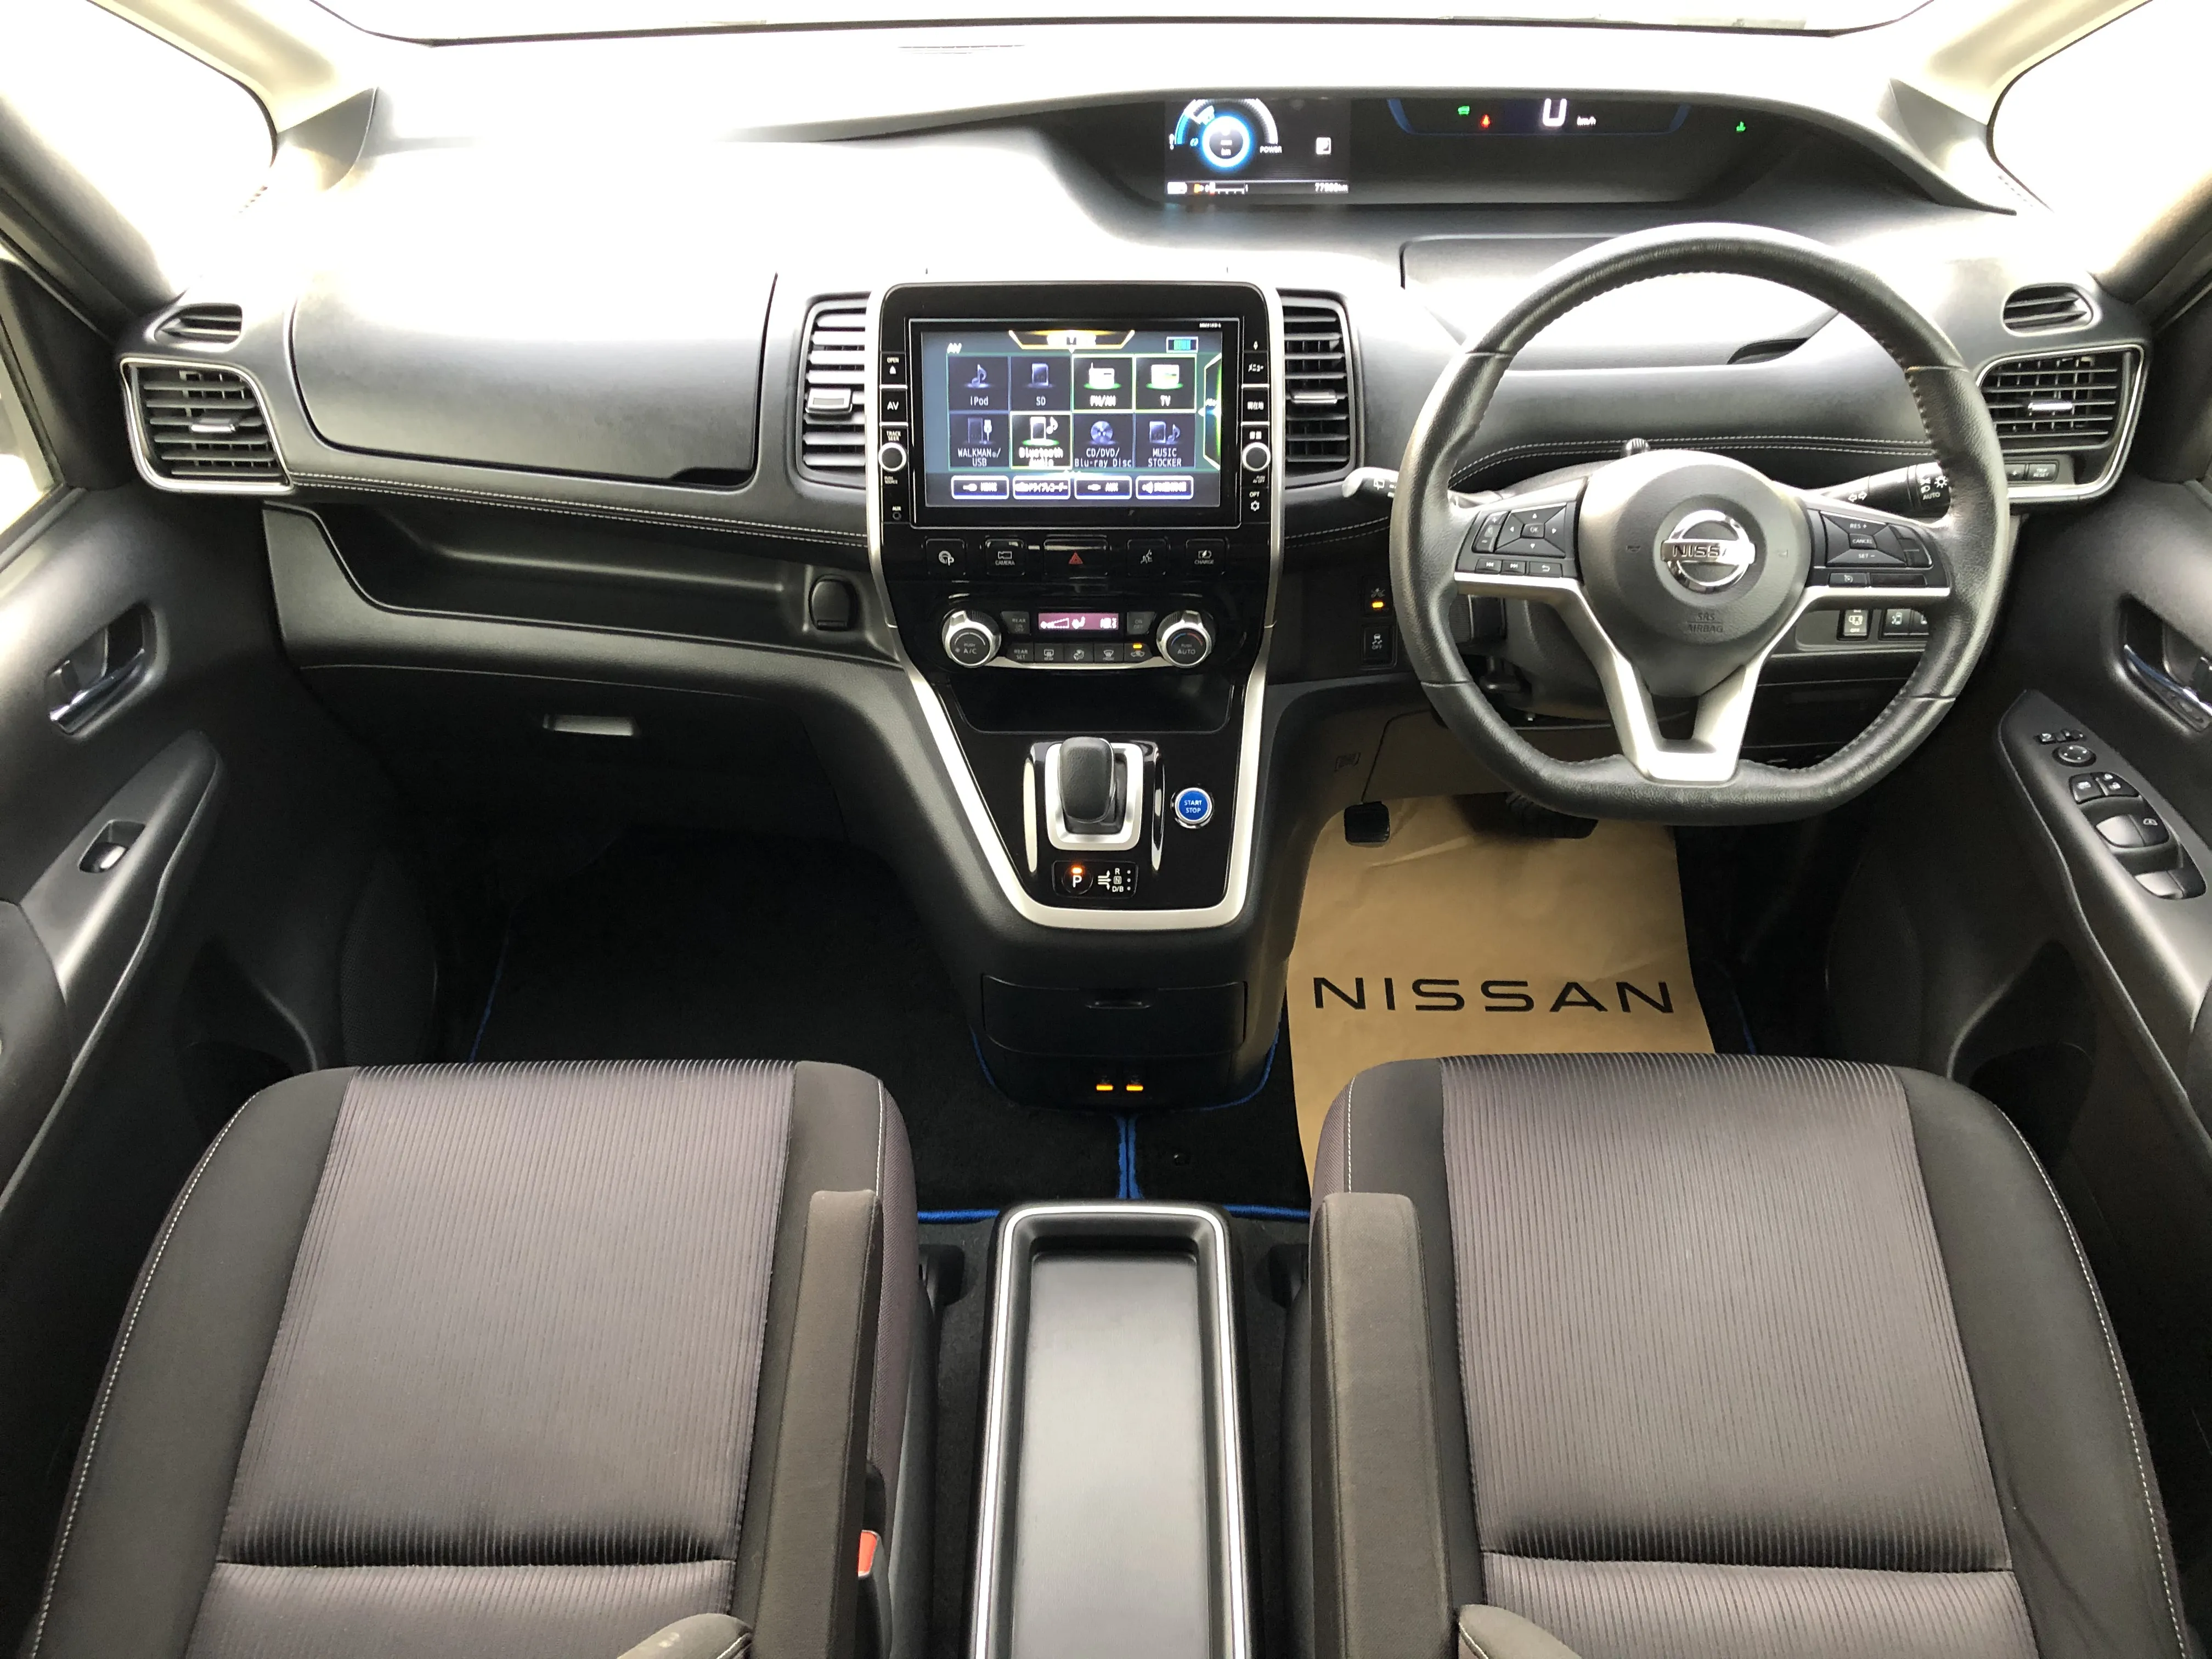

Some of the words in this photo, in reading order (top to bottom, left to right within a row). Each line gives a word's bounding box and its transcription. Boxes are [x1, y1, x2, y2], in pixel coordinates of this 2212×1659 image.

[887, 401, 899, 410] AV
[1036, 396, 1046, 406] SD
[1160, 394, 1171, 407] TV
[1086, 447, 1120, 458] CD/DVD/
[1152, 447, 1177, 457] MUSIC
[972, 458, 987, 467] USB
[1074, 458, 1108, 468] Blu-ray
[1112, 458, 1132, 467] Disc
[1148, 458, 1182, 467] STOCKER
[1922, 492, 1940, 500] AUTO
[1697, 612, 1715, 620] SRS
[1688, 624, 1723, 633] AIRBAG
[1073, 874, 1082, 888] P
[1313, 977, 1674, 1013] NISSAN
